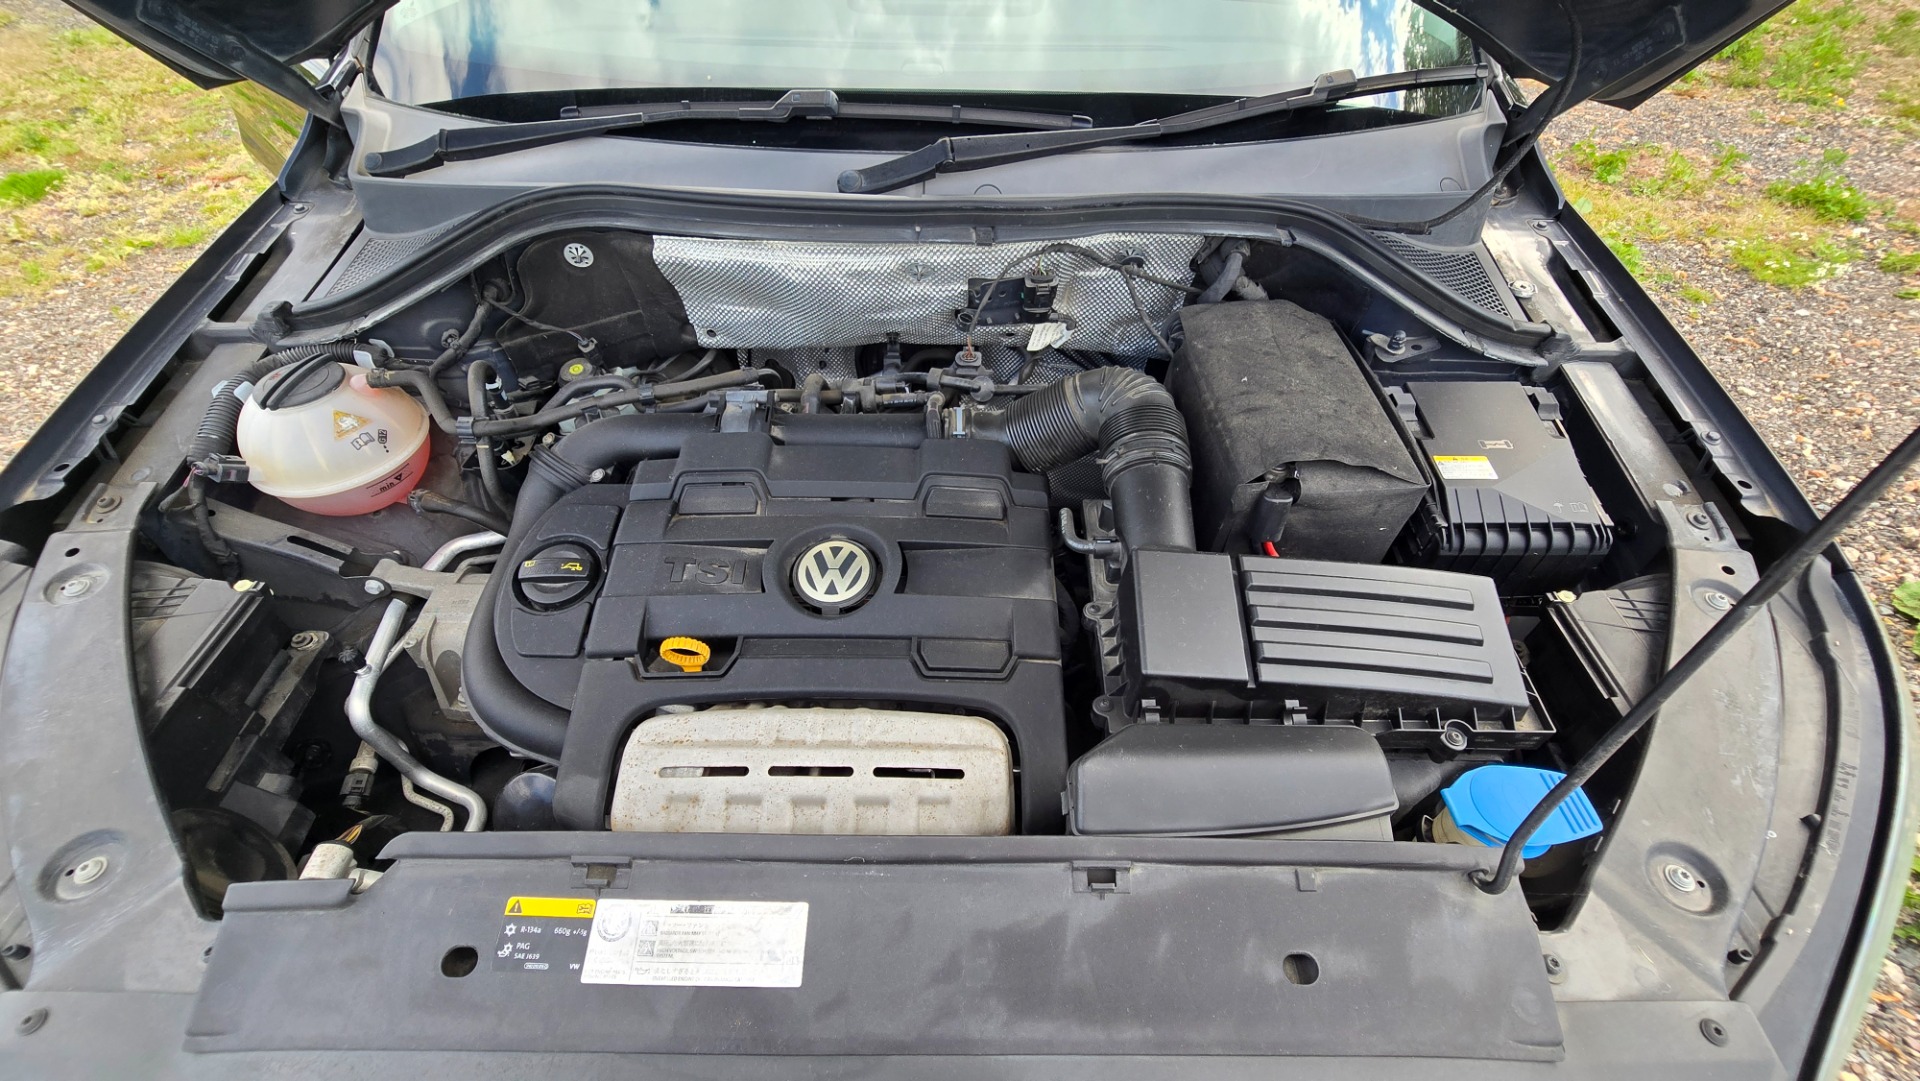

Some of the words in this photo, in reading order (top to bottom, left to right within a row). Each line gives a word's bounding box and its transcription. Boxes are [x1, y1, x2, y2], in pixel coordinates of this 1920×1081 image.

[380, 482, 395, 492] min
[664, 556, 748, 584] TSI
[520, 926, 542, 934] R-134a
[554, 926, 571, 937] 660g
[516, 942, 530, 950] PAG
[514, 952, 525, 960] SAE
